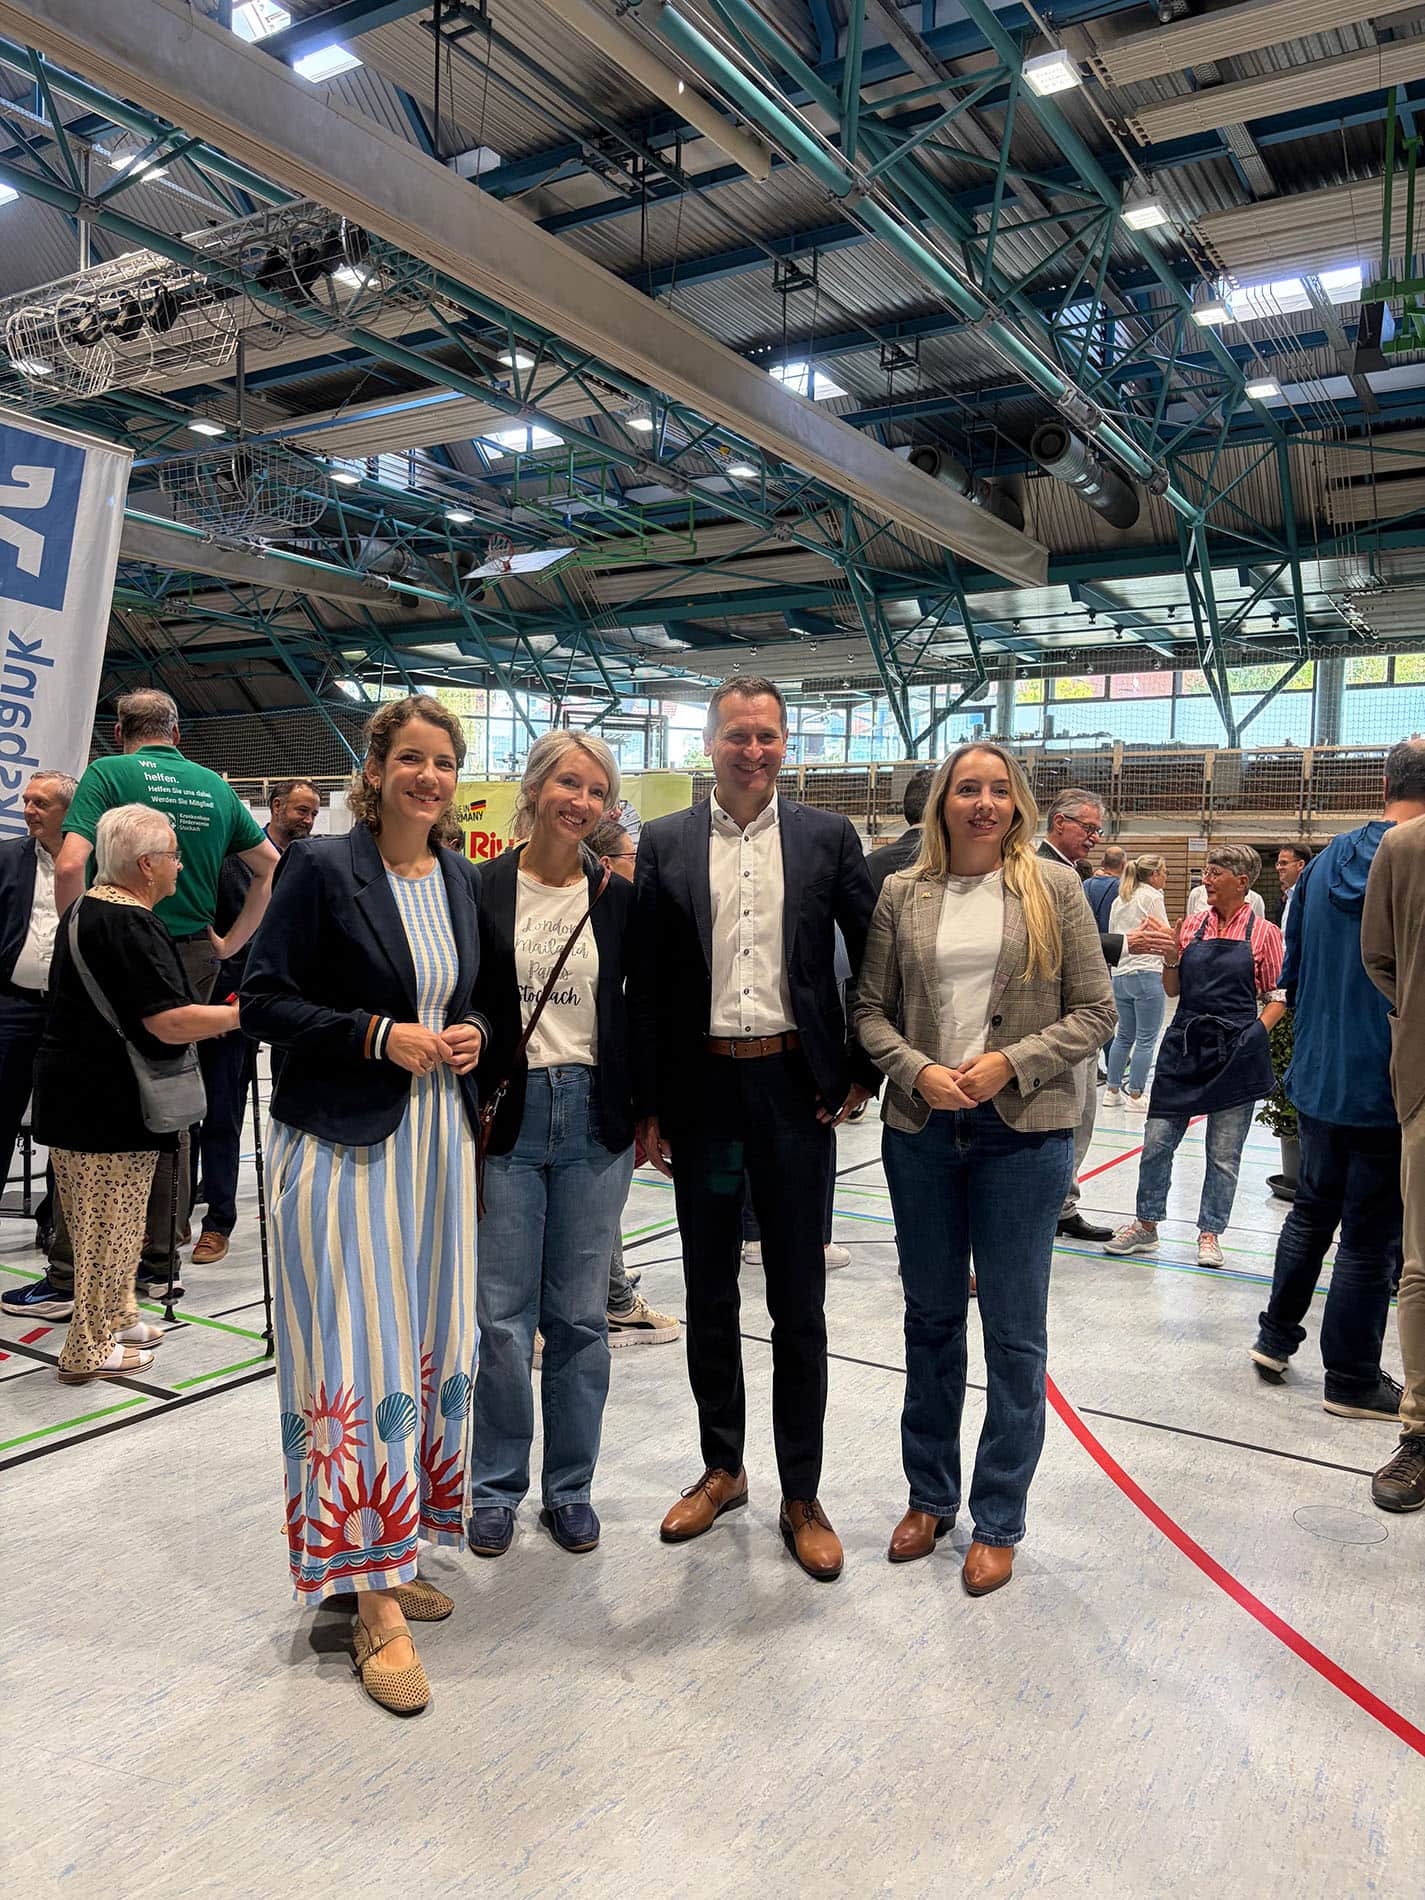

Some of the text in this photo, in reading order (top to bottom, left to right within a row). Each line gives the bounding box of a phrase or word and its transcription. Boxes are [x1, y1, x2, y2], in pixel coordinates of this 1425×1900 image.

[139, 760, 156, 768] Wir
[144, 772, 179, 783] helfen.
[528, 960, 574, 980] Pars
